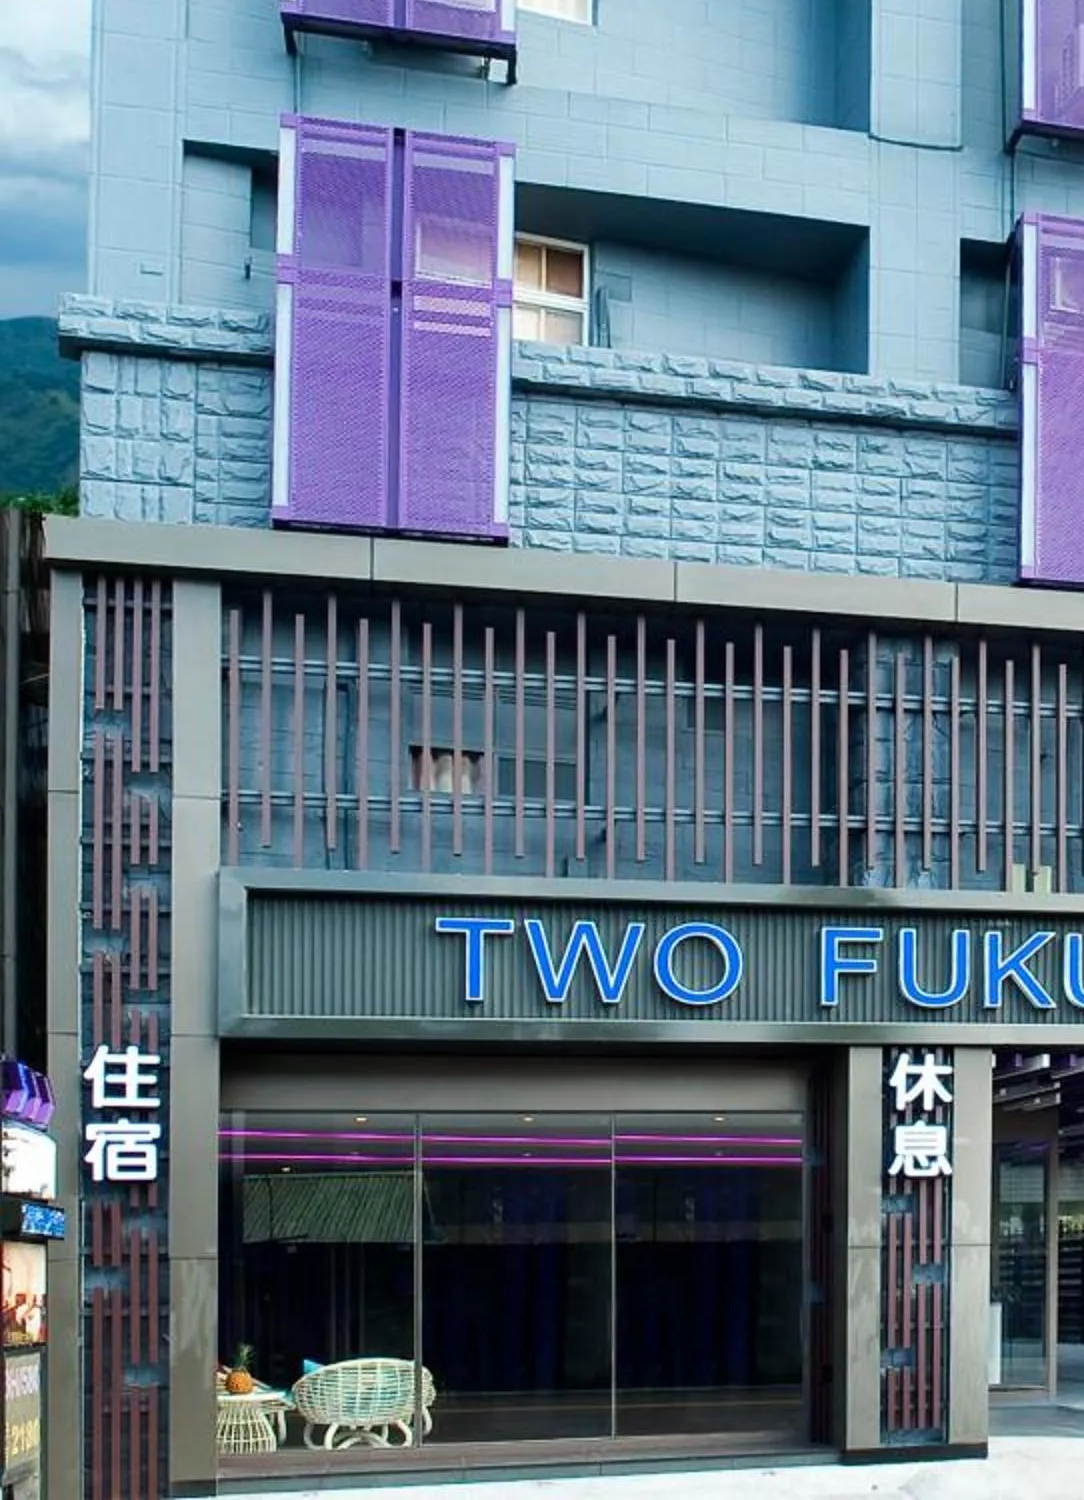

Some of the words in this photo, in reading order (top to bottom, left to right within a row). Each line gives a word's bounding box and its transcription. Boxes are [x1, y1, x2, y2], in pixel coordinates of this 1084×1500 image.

[434, 916, 744, 1006] TWO
[83, 1045, 162, 1182] 住宿
[889, 1052, 953, 1178] 休息
